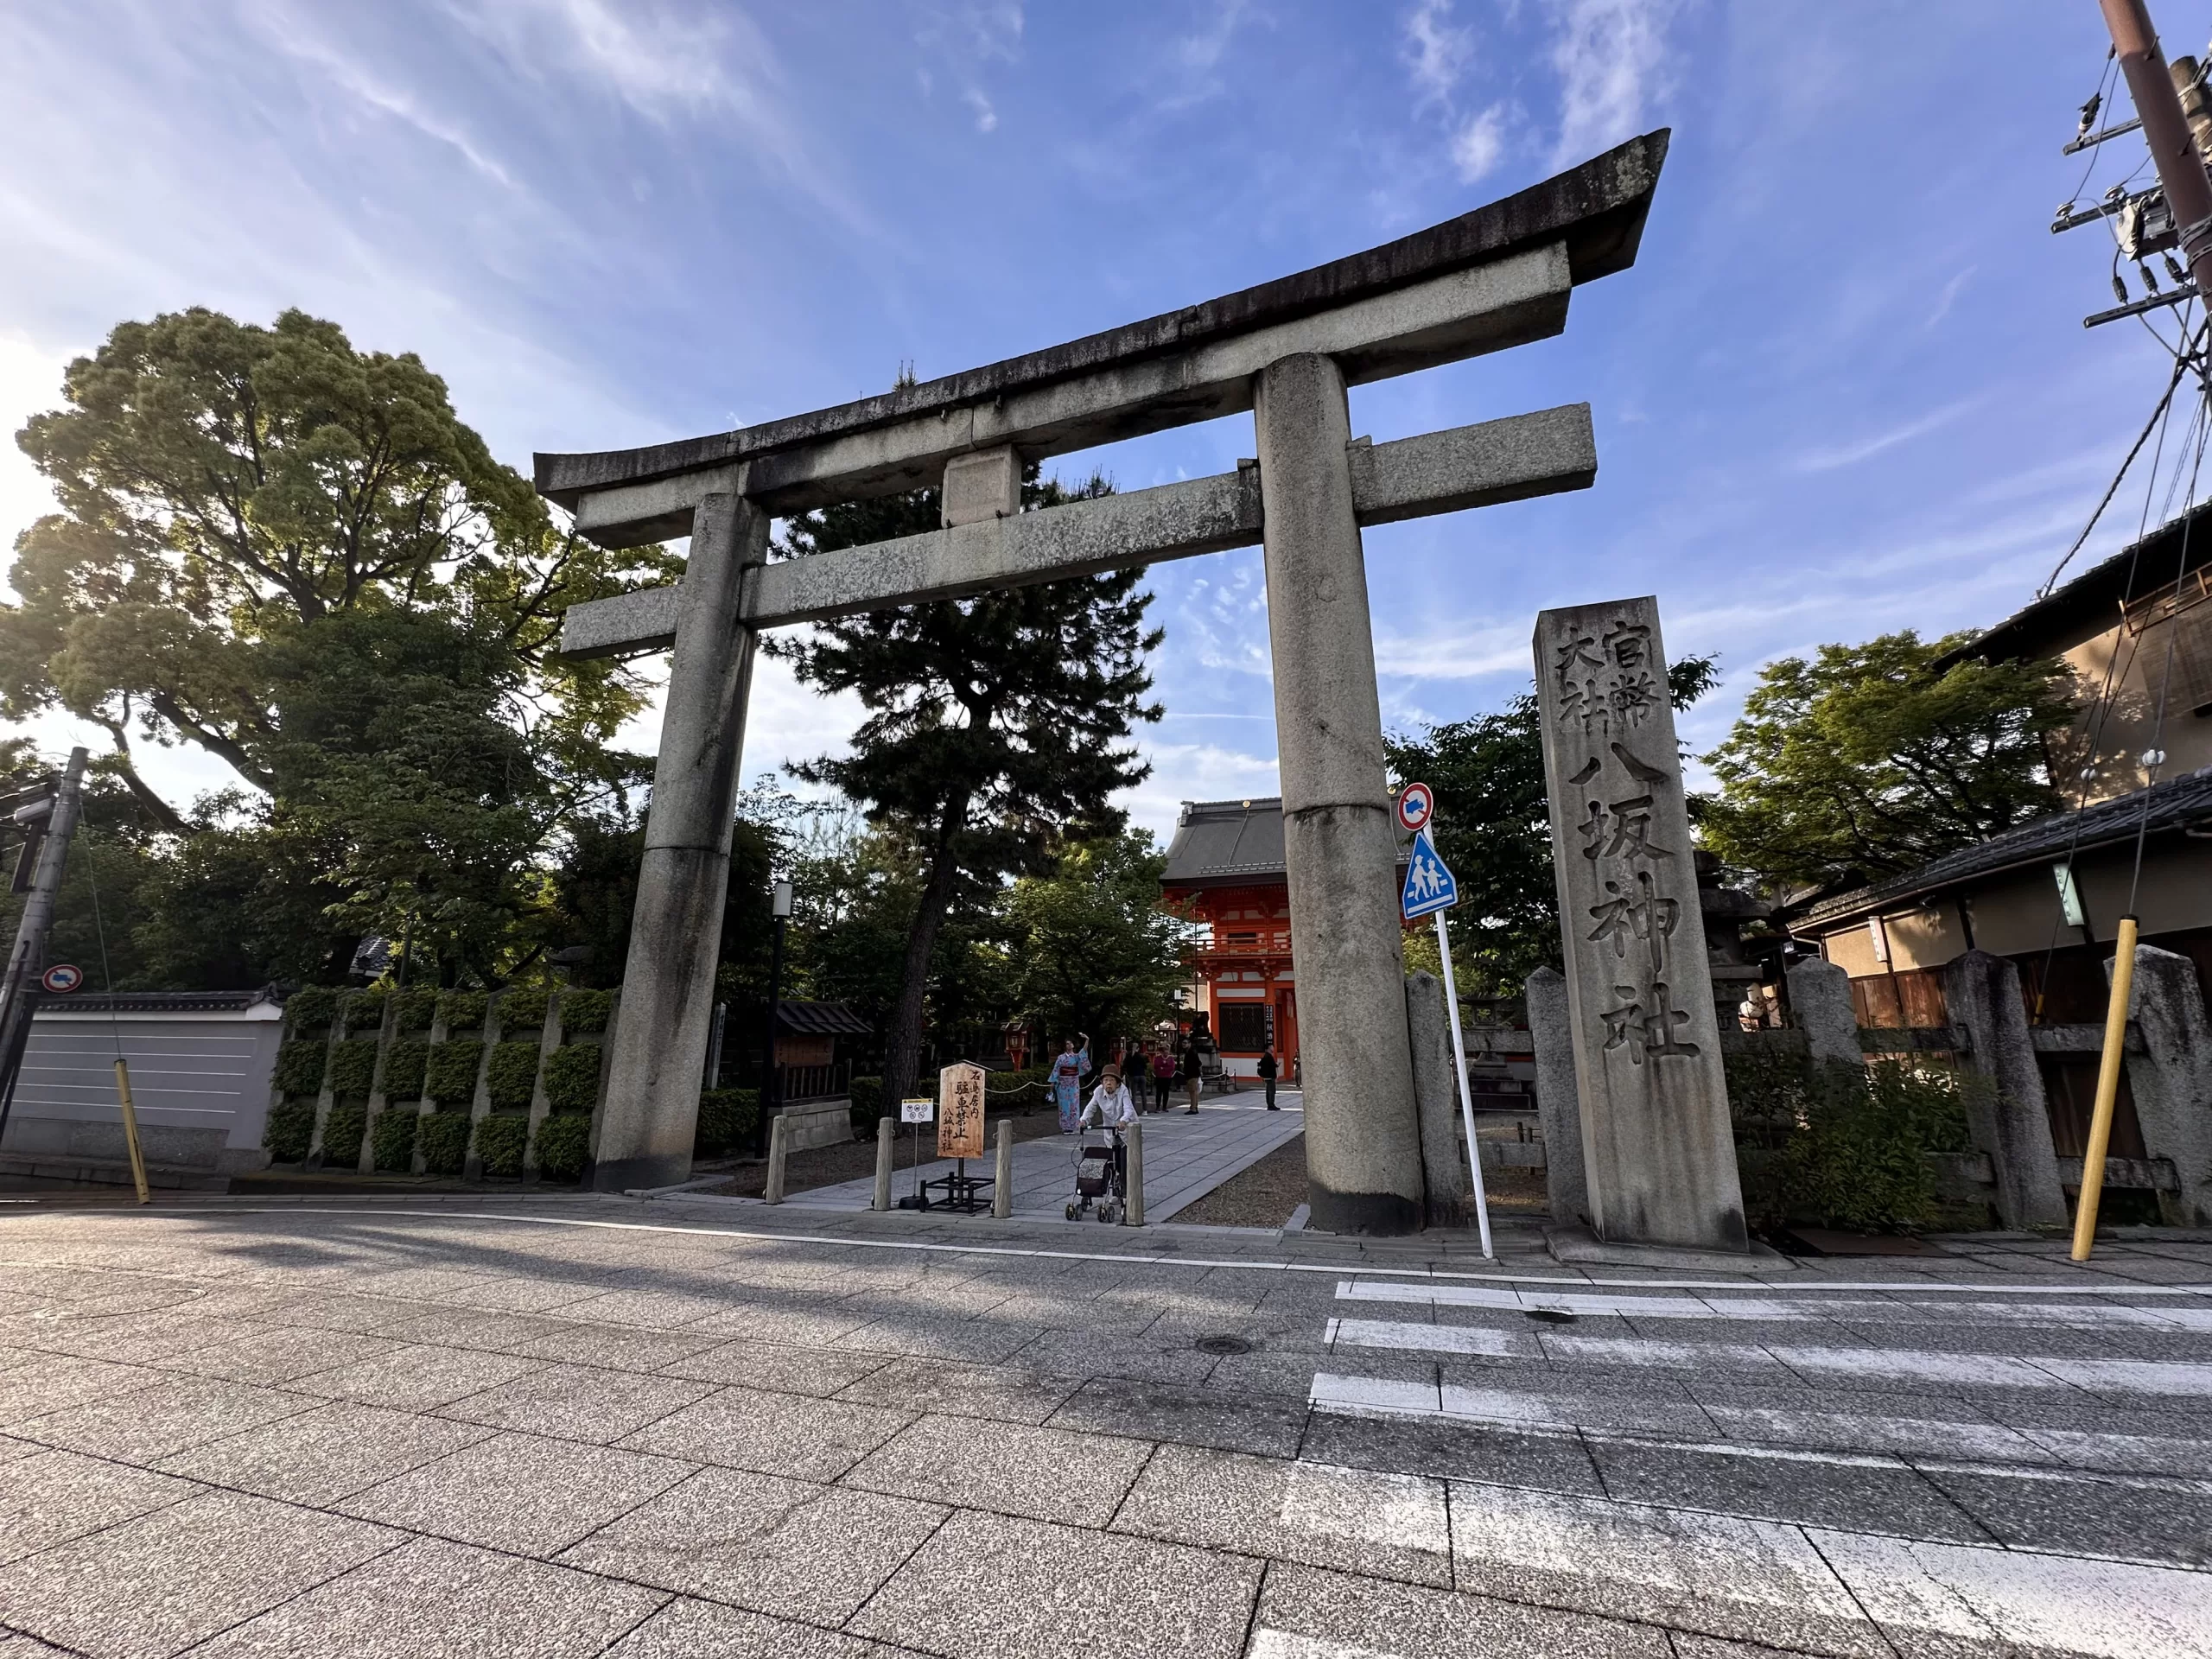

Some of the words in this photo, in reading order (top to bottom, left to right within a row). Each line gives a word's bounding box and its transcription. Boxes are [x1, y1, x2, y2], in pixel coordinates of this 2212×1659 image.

[1555, 627, 1609, 727] 大社
[1568, 741, 1700, 1065] 八坂神社
[942, 1108, 955, 1152] 八坂神社
[953, 1081, 969, 1139] 駐車禁止
